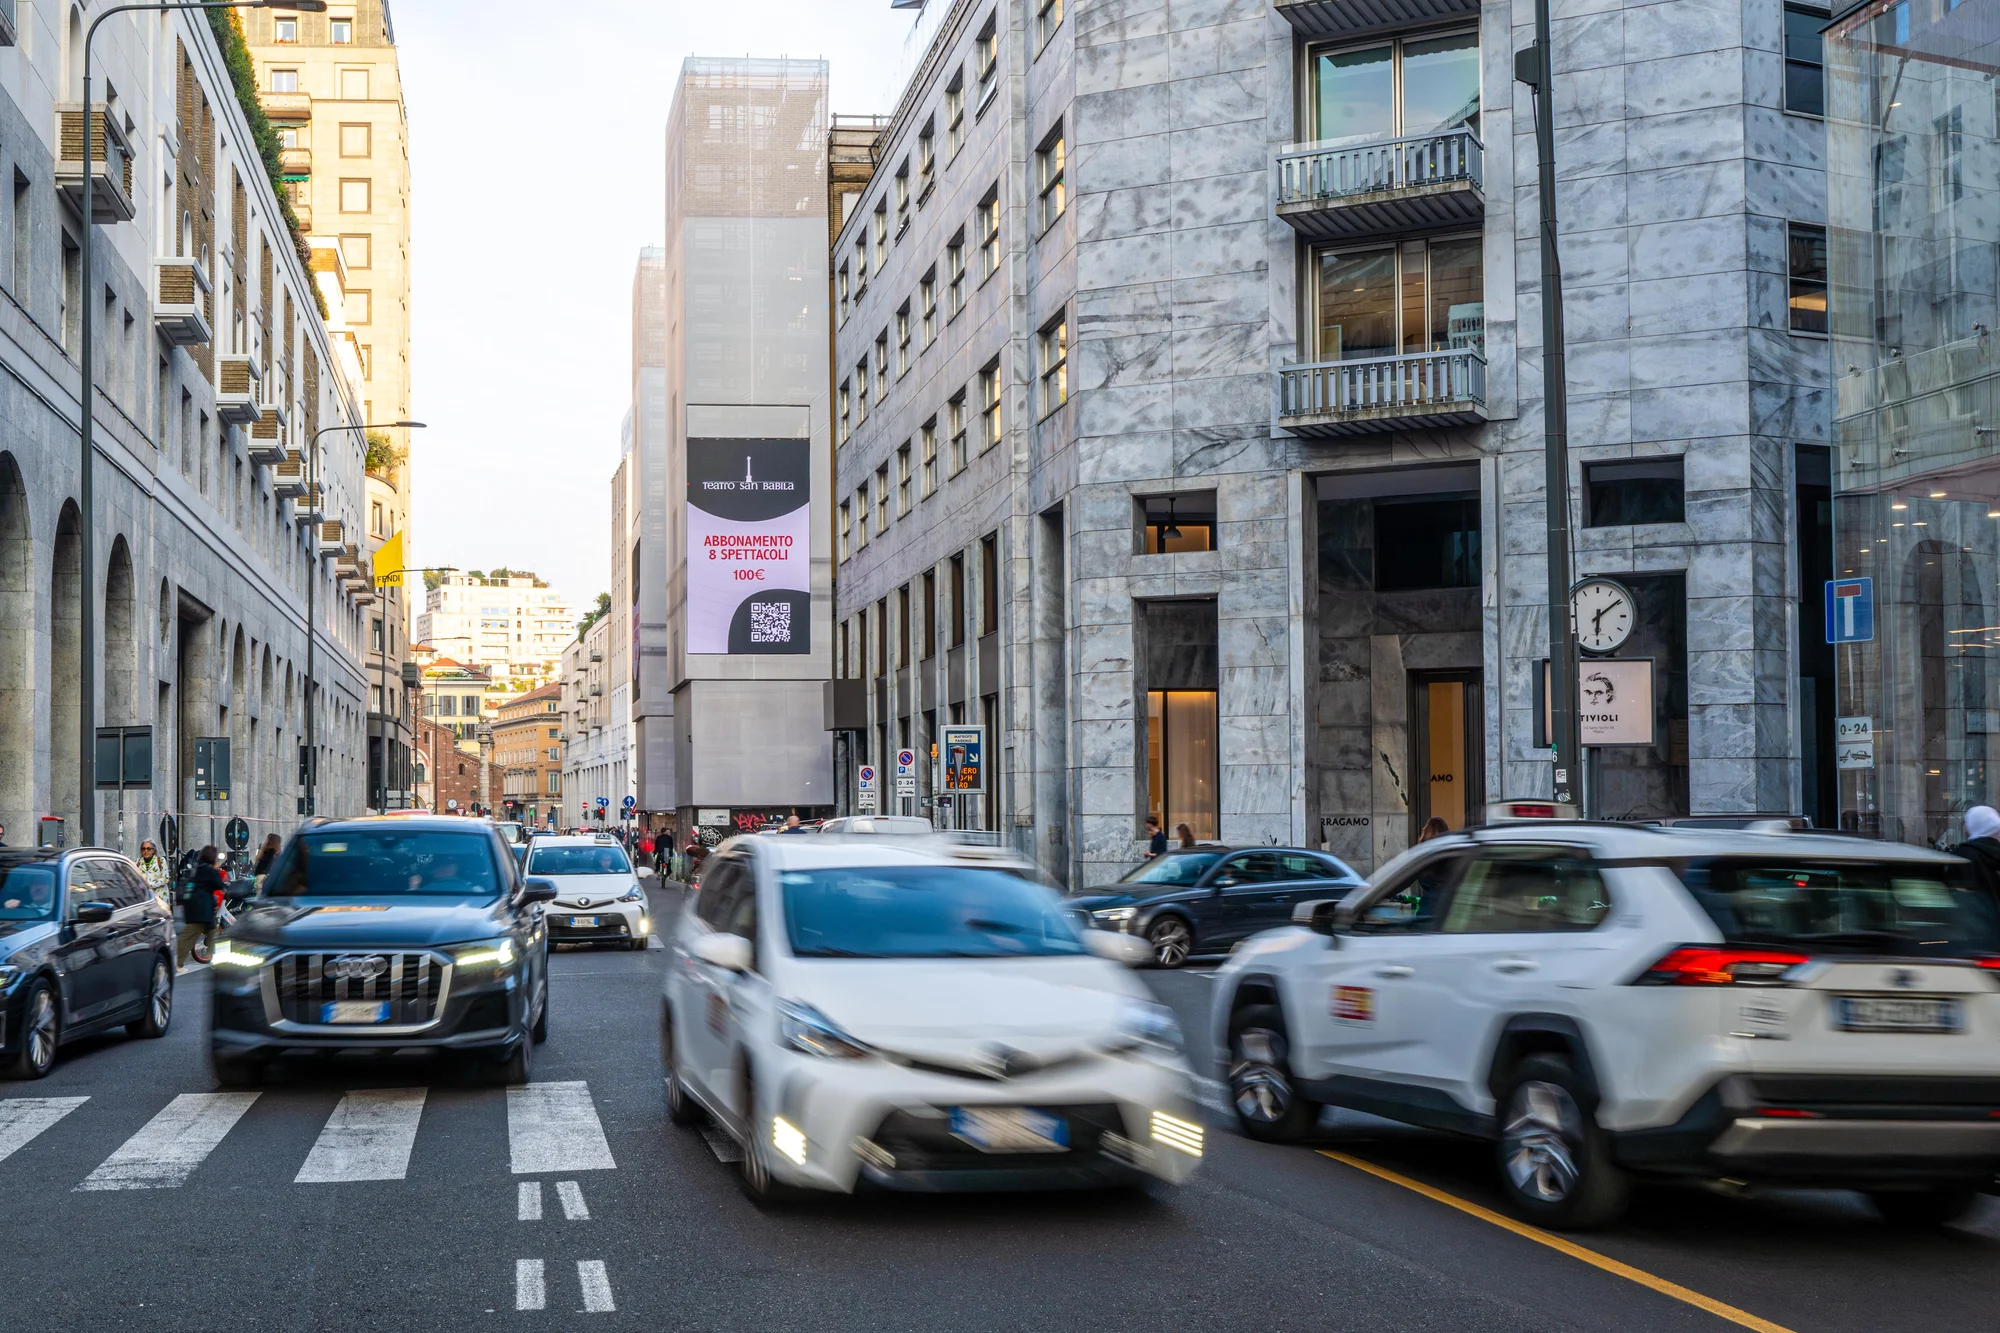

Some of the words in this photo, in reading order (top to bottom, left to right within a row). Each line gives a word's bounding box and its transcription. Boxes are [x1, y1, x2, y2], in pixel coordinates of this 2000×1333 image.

[703, 535, 793, 547] ABBONAMENTO
[708, 549, 717, 560] 8
[720, 549, 788, 560] SPETTACOLI
[377, 574, 401, 583] FENDI
[733, 568, 765, 581] 100€
[949, 781, 968, 789] ERO
